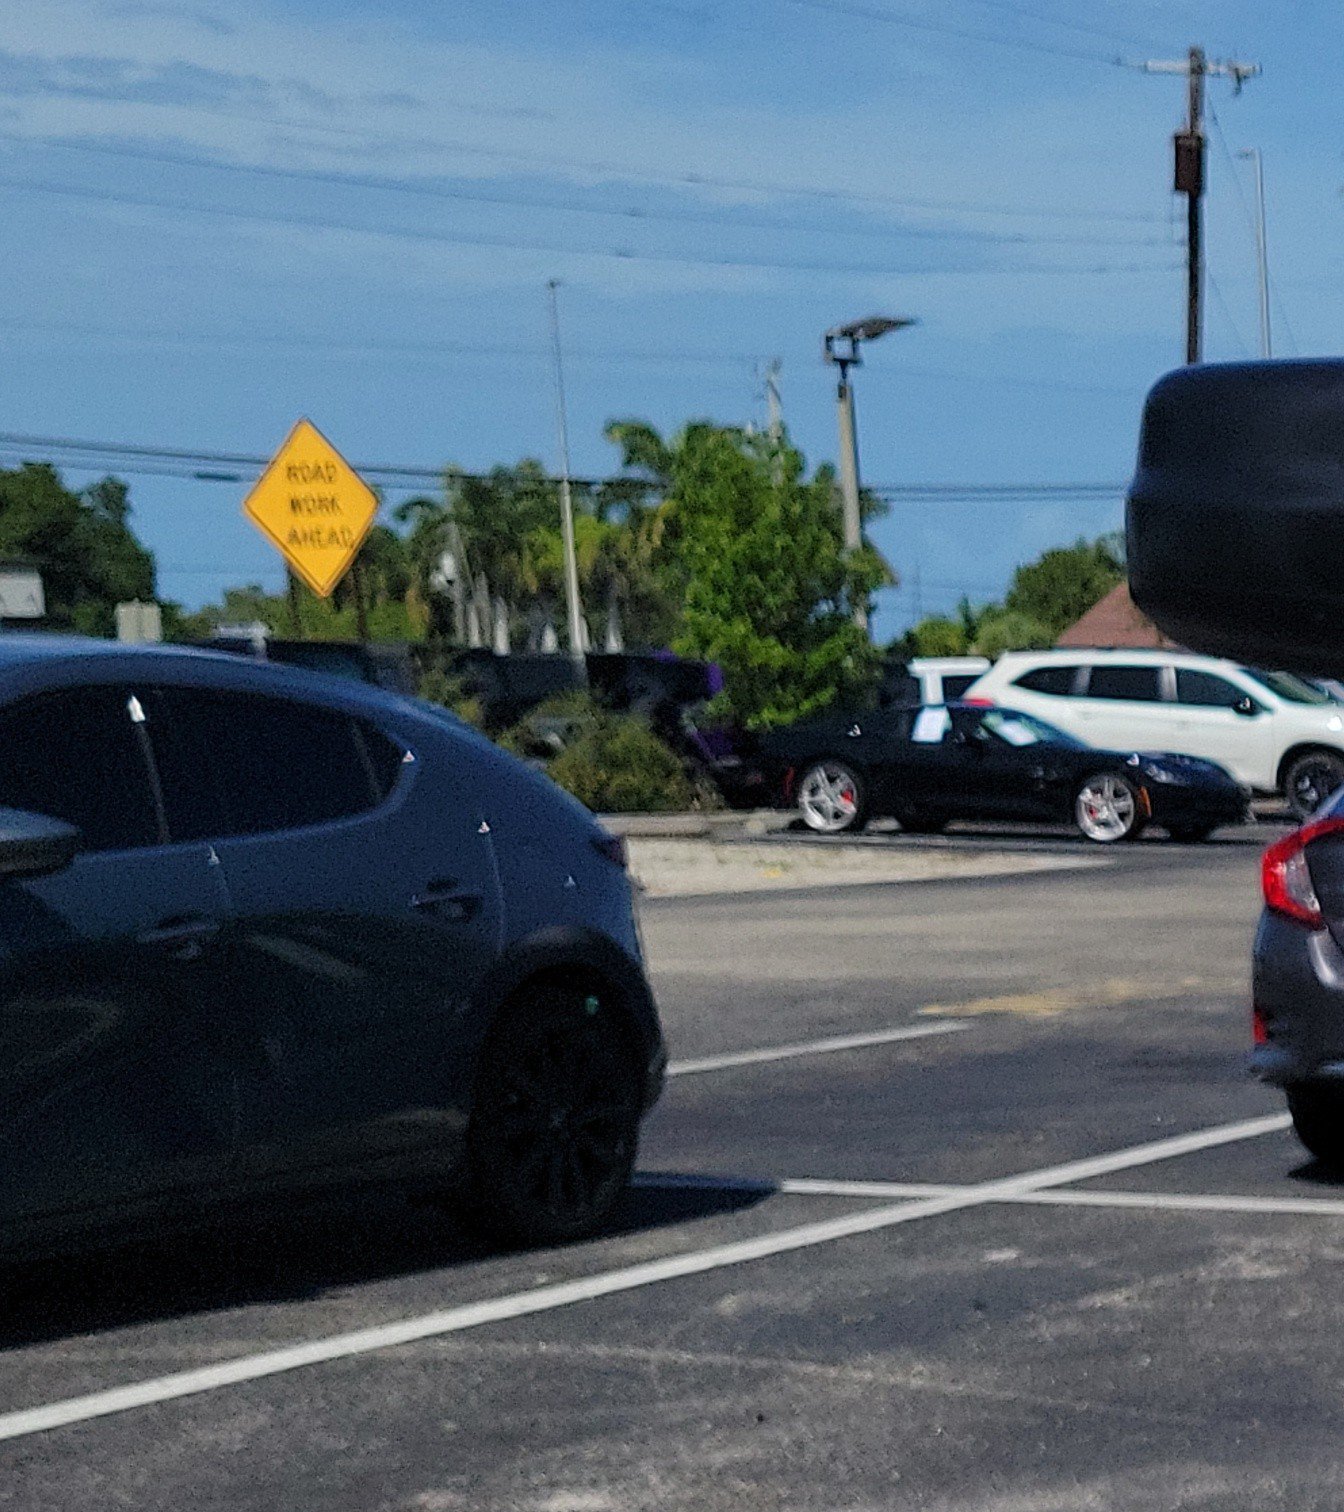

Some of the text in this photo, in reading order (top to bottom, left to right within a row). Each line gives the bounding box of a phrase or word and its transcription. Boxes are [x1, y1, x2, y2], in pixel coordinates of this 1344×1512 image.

[287, 462, 336, 483] ROAD
[290, 496, 341, 514] WORK
[288, 528, 352, 549] AHEAD
